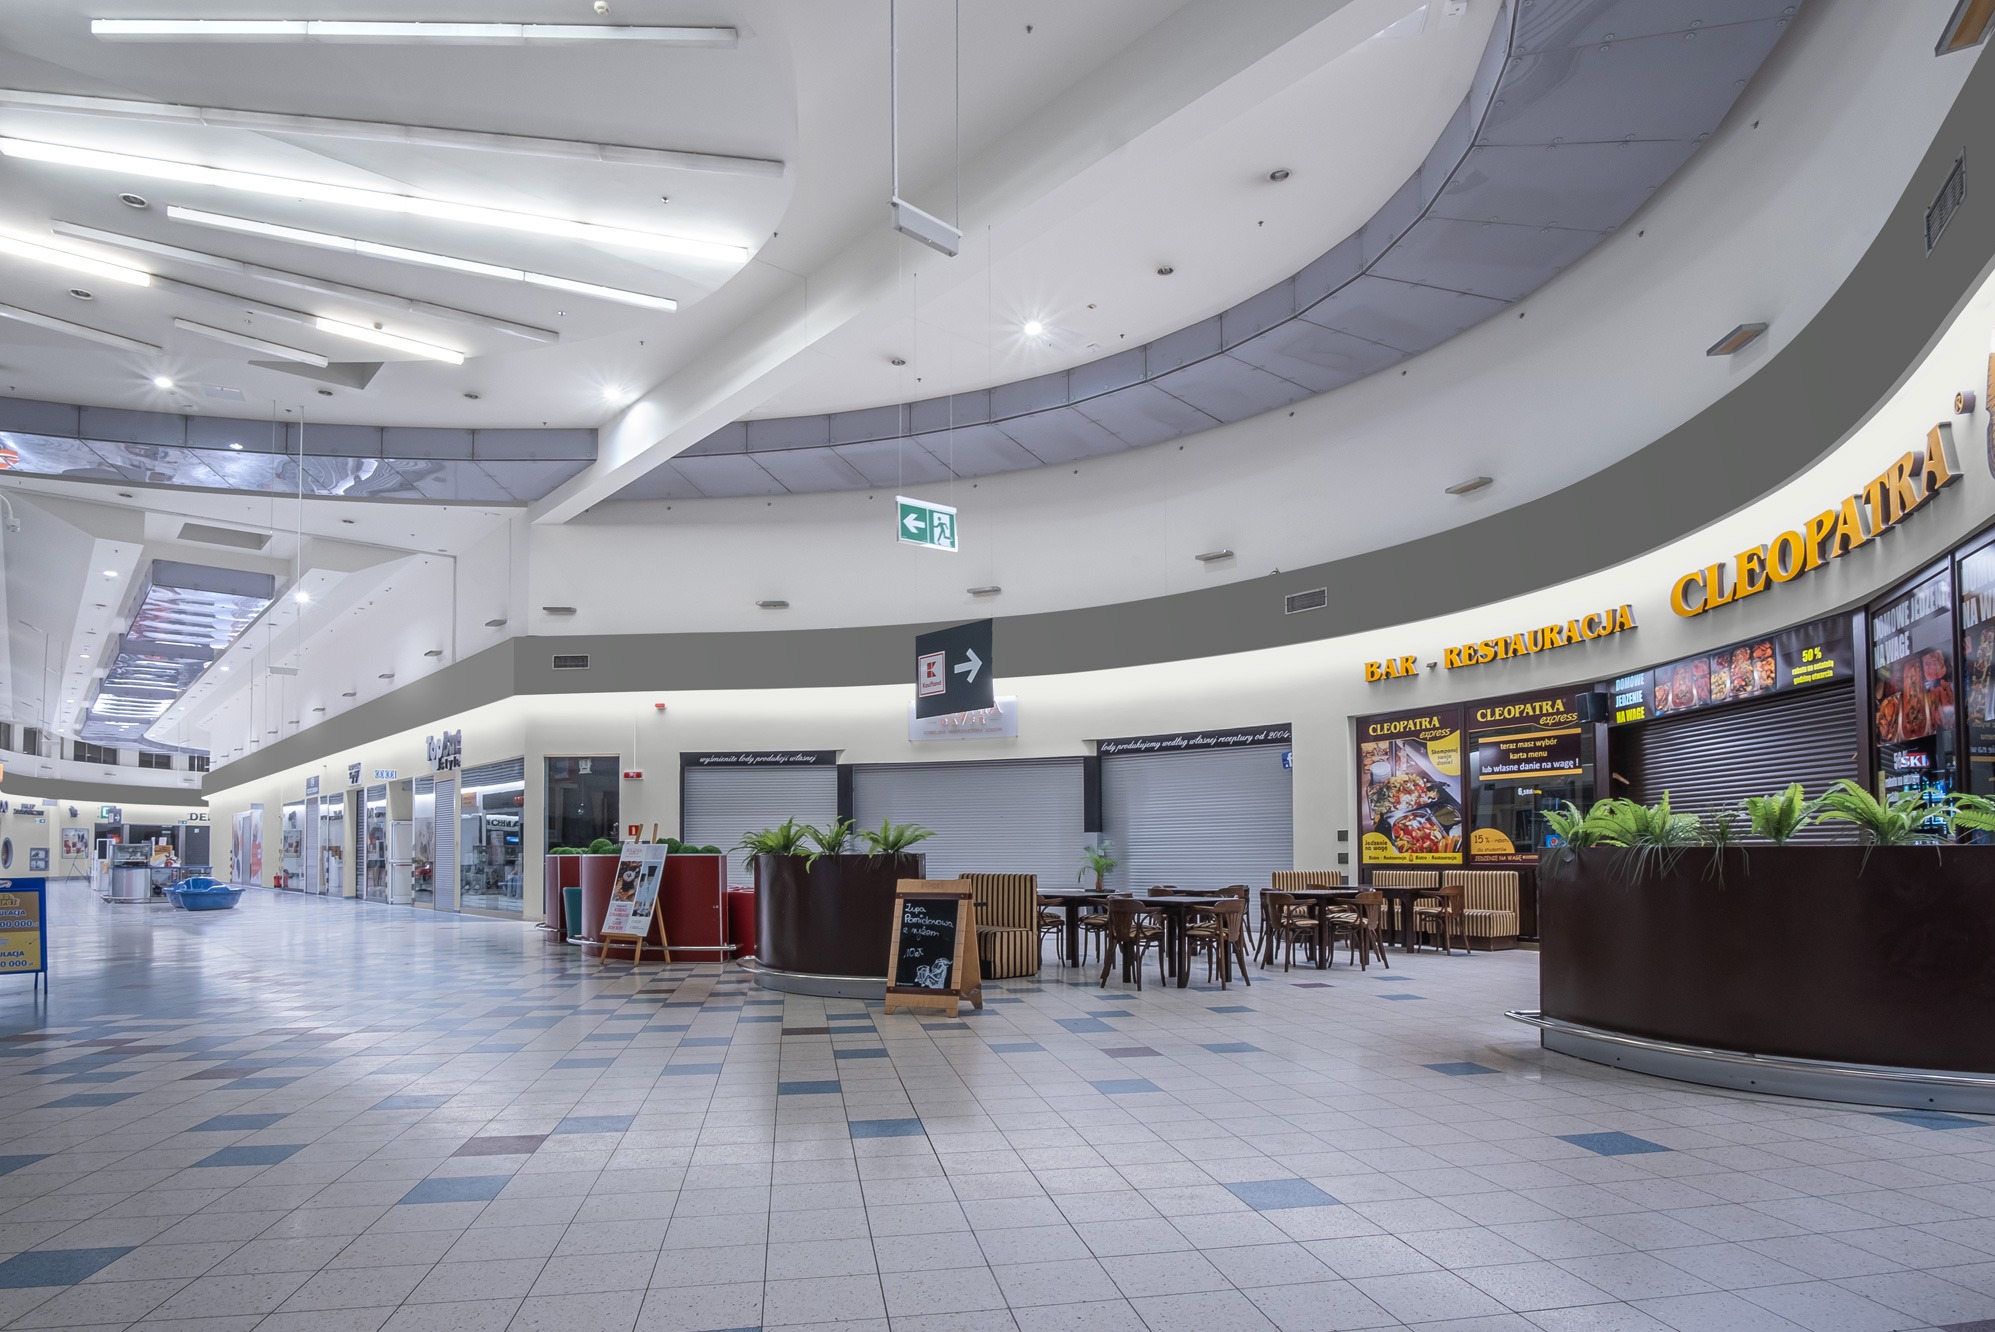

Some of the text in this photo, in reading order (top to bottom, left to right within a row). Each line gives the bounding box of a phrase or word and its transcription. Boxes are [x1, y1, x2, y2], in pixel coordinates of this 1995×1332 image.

[1670, 421, 1963, 618] CLEOPATRA
[1364, 655, 1419, 683] BAR
[1444, 604, 1639, 670] RESTAURACJA
[1802, 649, 1814, 662] 50
[922, 680, 942, 689] Kaufland
[1615, 690, 1643, 708] JEDZENIE
[1476, 699, 1565, 722] CLEOPATRA
[1539, 712, 1578, 726] express
[1368, 716, 1440, 736] CLEOPATRA
[1419, 728, 1452, 740] express
[1100, 742, 1116, 753] lody
[1115, 739, 1161, 752] produkujemy
[1162, 736, 1188, 748] według
[1189, 735, 1218, 746] własnej
[1218, 732, 1254, 745] receptury
[1254, 730, 1267, 741] od
[1535, 737, 1558, 748] wybór
[699, 754, 738, 765] wyśmienite
[738, 753, 754, 764] lody
[789, 752, 817, 763] własnej
[1509, 752, 1527, 760] karta
[1493, 763, 1518, 772] własne
[1519, 761, 1541, 770] danie
[1553, 760, 1574, 769] wagę
[1474, 834, 1484, 844] 15
[905, 903, 926, 913] Zupa
[904, 913, 954, 928] Pomidorowa
